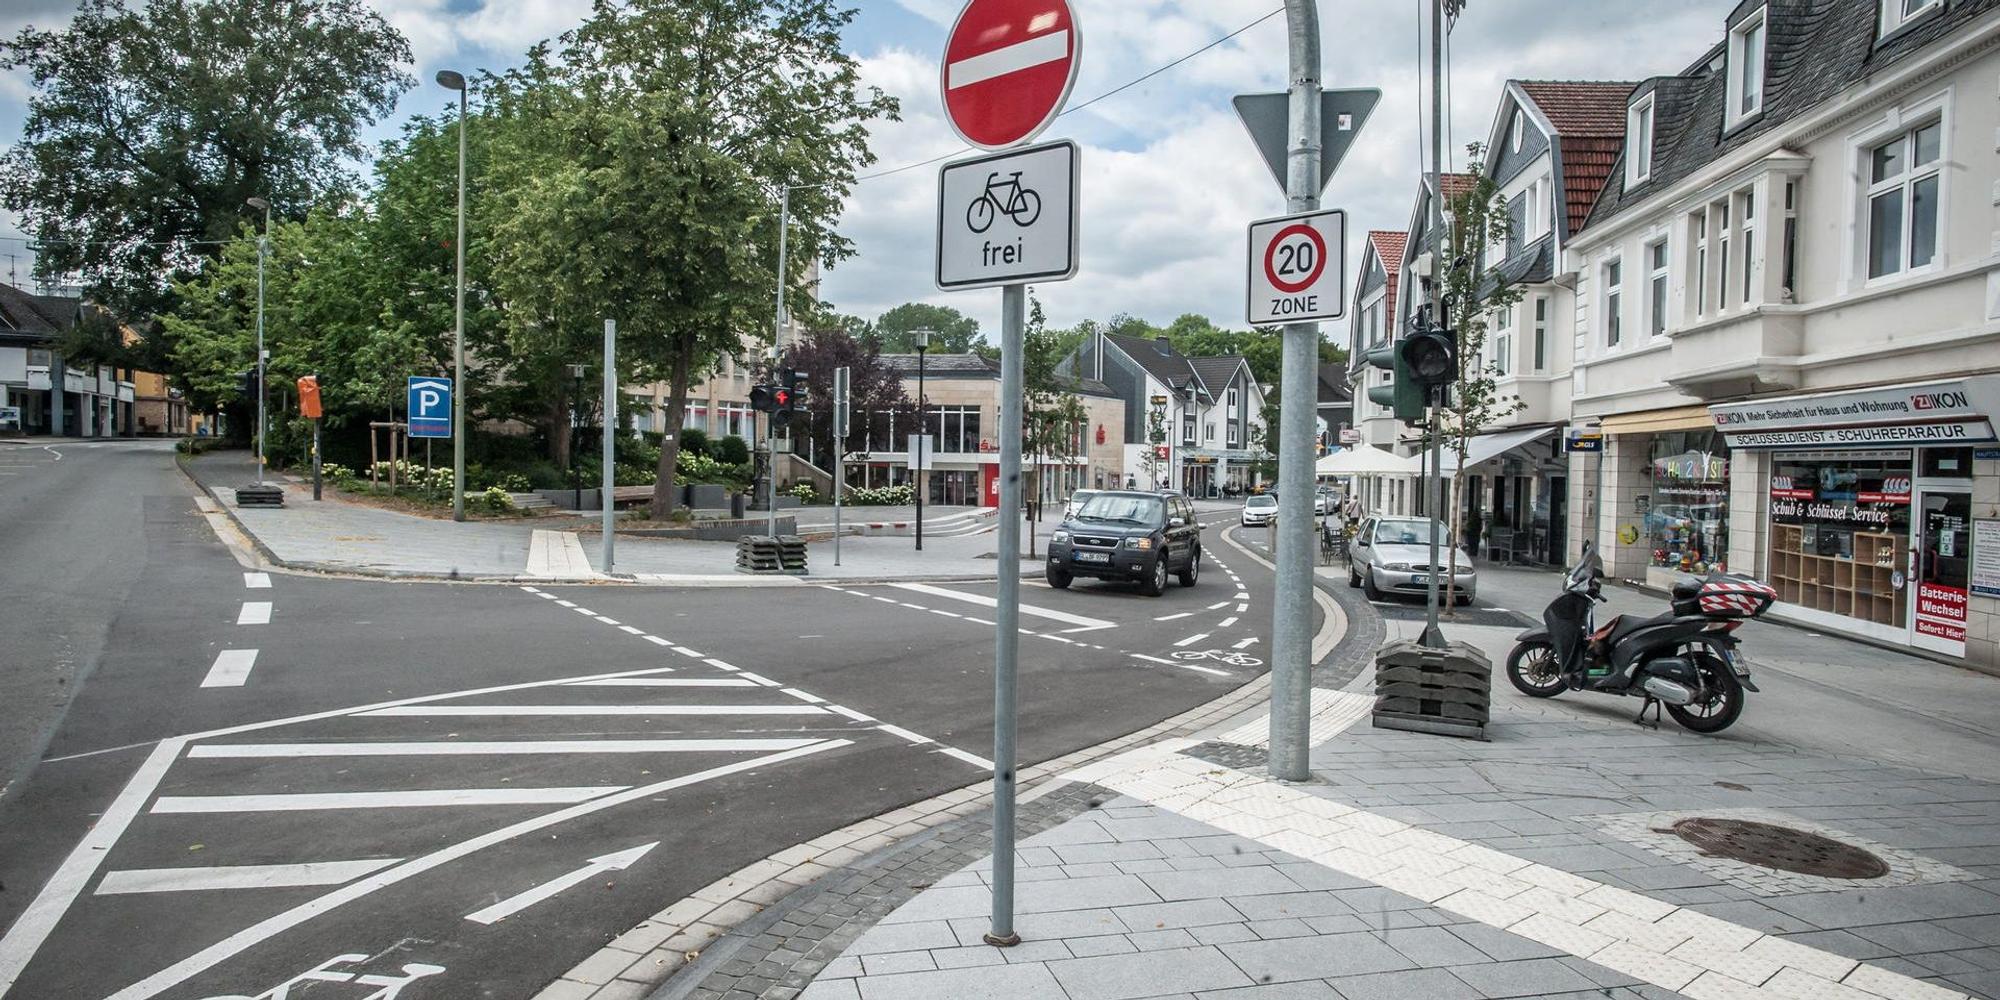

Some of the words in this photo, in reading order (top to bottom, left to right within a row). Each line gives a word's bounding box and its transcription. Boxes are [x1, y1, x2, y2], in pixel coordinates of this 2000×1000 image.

[982, 237, 1023, 267] frei
[1278, 242, 1313, 275] 20
[1271, 295, 1318, 316] ZONE
[420, 390, 440, 416] P
[1746, 412, 1766, 421] Mehr
[1766, 409, 1804, 420] Sicherheit
[1818, 406, 1840, 417] Haus
[1842, 404, 1859, 415] und
[1859, 400, 1909, 413] Wohnung
[1828, 434, 1835, 442] +
[1838, 425, 1966, 440] SCHUHREPARATUR
[1772, 501, 1796, 516] Schuh
[1806, 503, 1847, 520] Schlüssel
[1852, 506, 1889, 523] Service
[1920, 585, 1967, 604] Batterie-
[1921, 600, 1964, 619] Wechsel
[1918, 622, 1945, 636] Sofort!
[1946, 627, 1966, 640] Hier!
